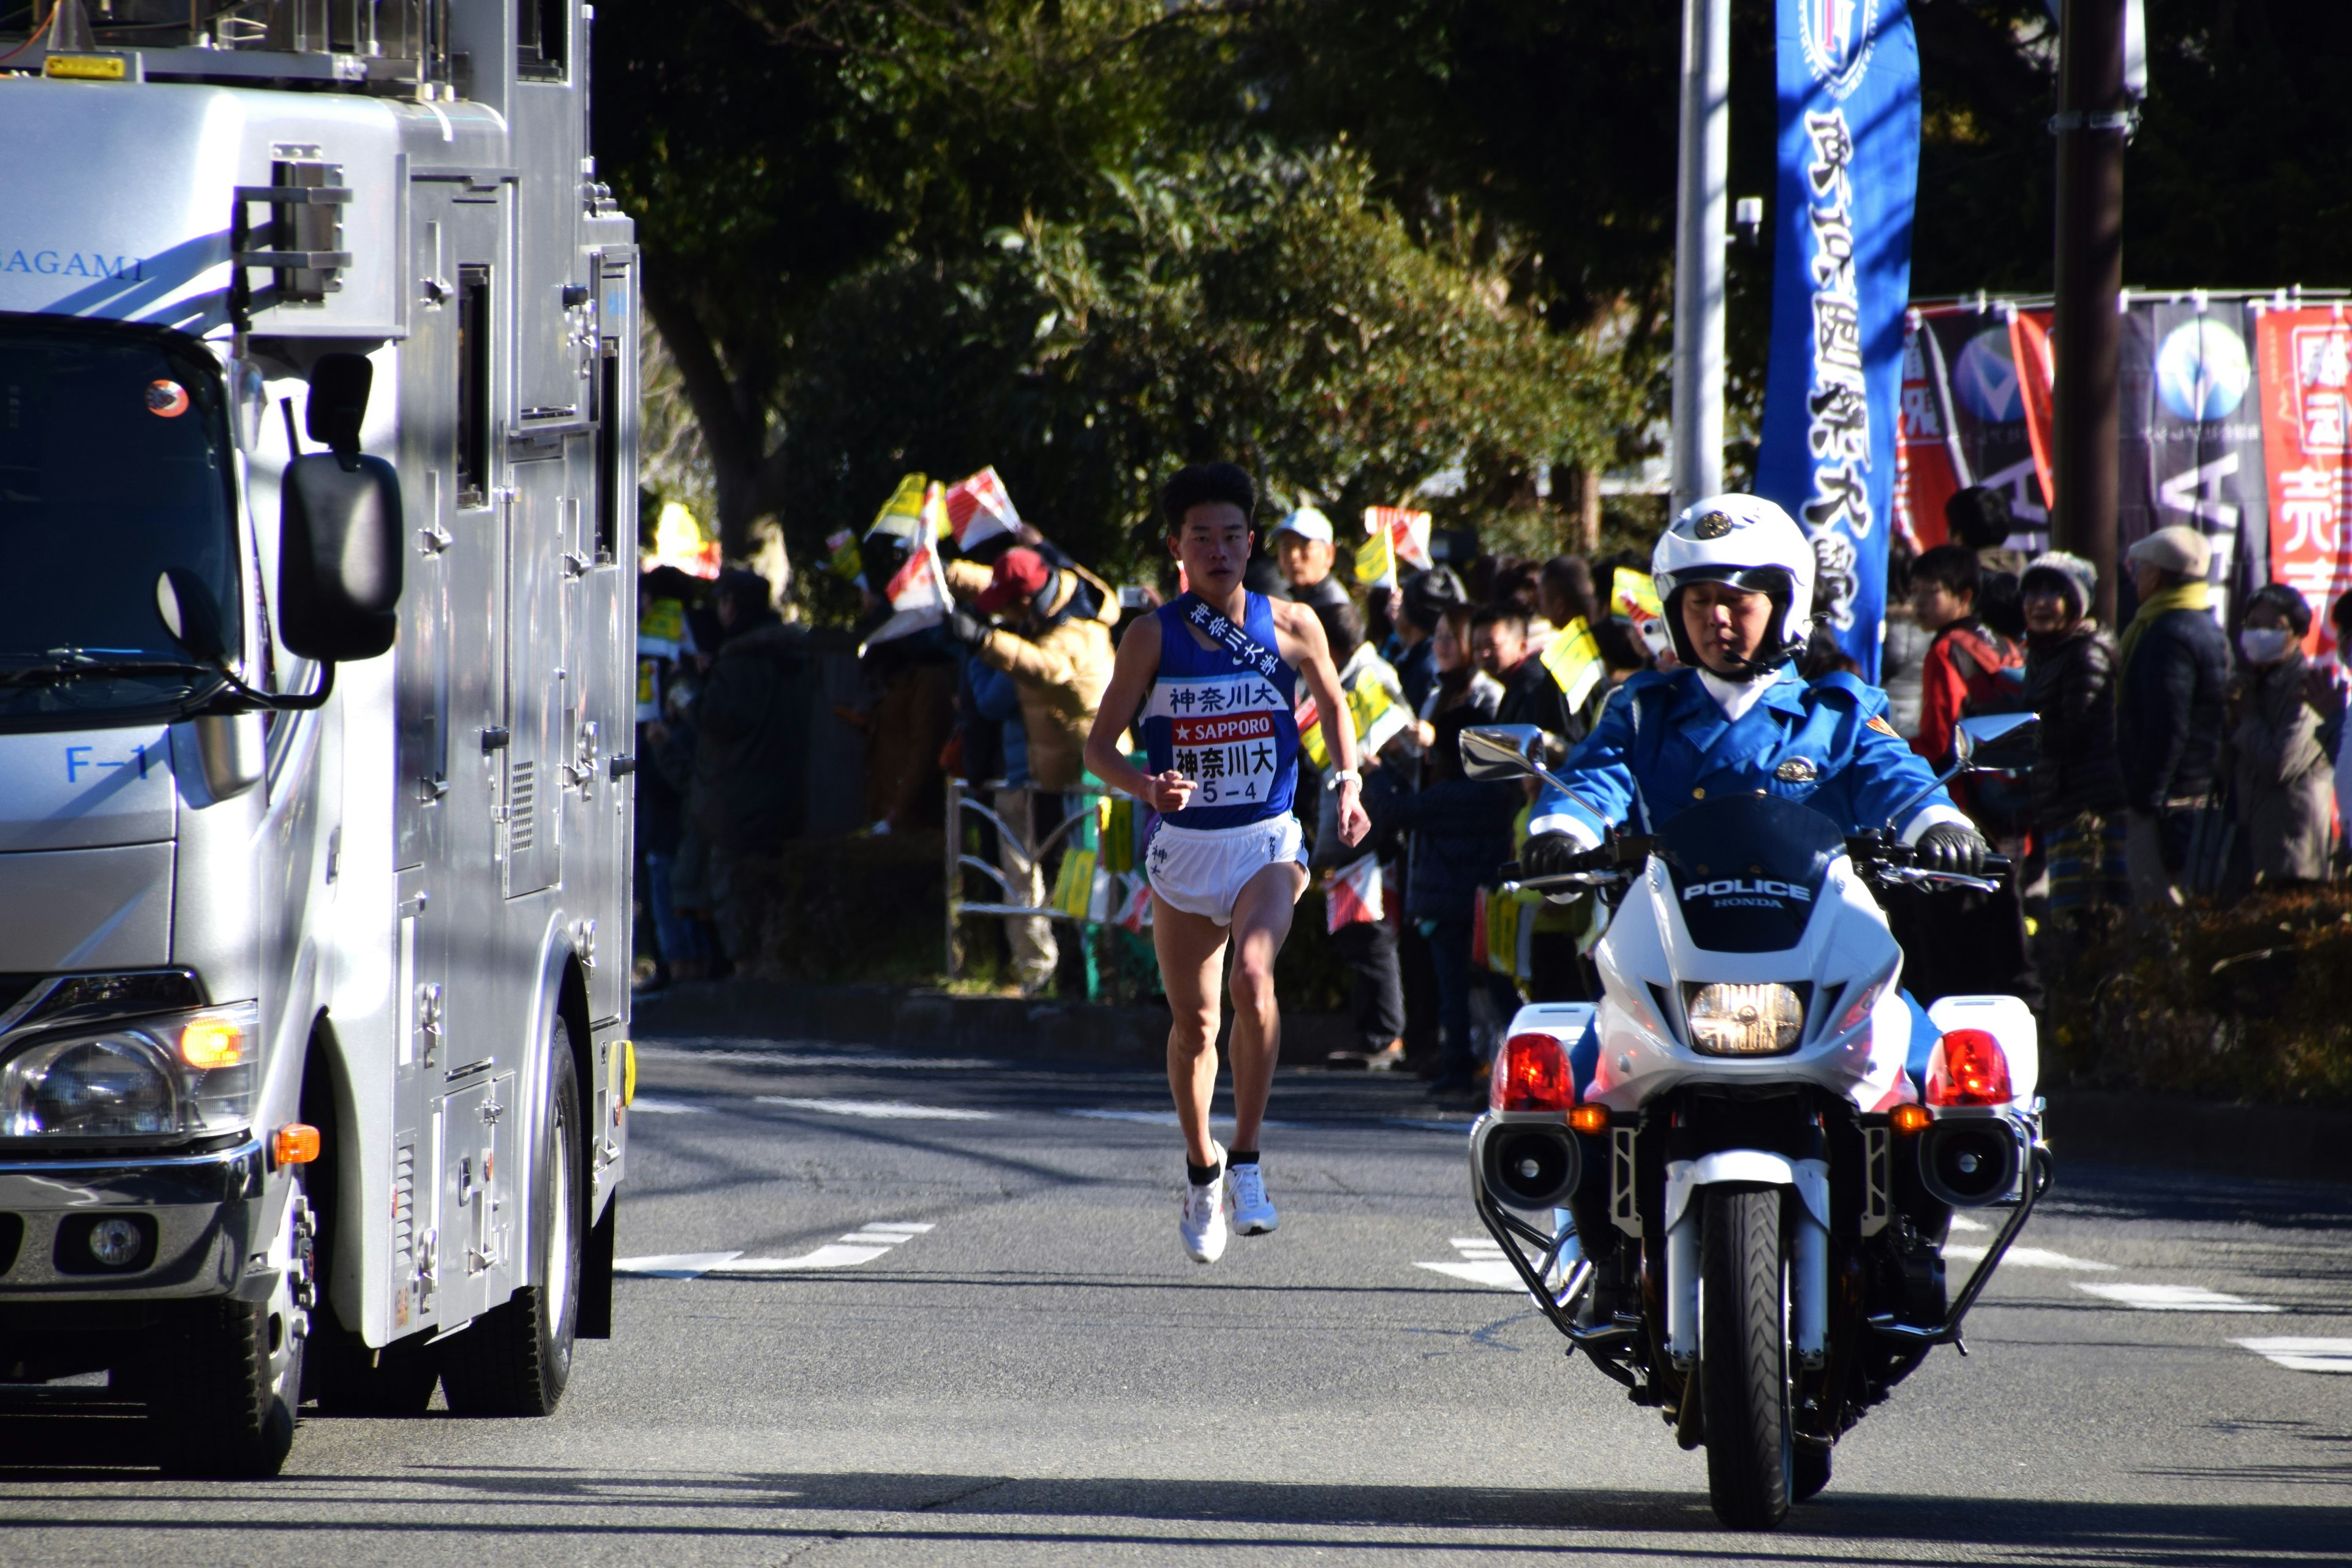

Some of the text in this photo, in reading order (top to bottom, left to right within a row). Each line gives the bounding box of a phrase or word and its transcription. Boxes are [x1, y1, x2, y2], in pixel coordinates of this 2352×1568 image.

[0, 249, 146, 282] AGAMI
[1190, 603, 1279, 676] 神奈川大学
[1170, 683, 1278, 714] 神奈川大
[1195, 717, 1270, 741] SAPPORO
[1176, 742, 1274, 780] 神奈川大
[1684, 880, 1811, 902] POLICE
[1714, 897, 1784, 908] HONDA
